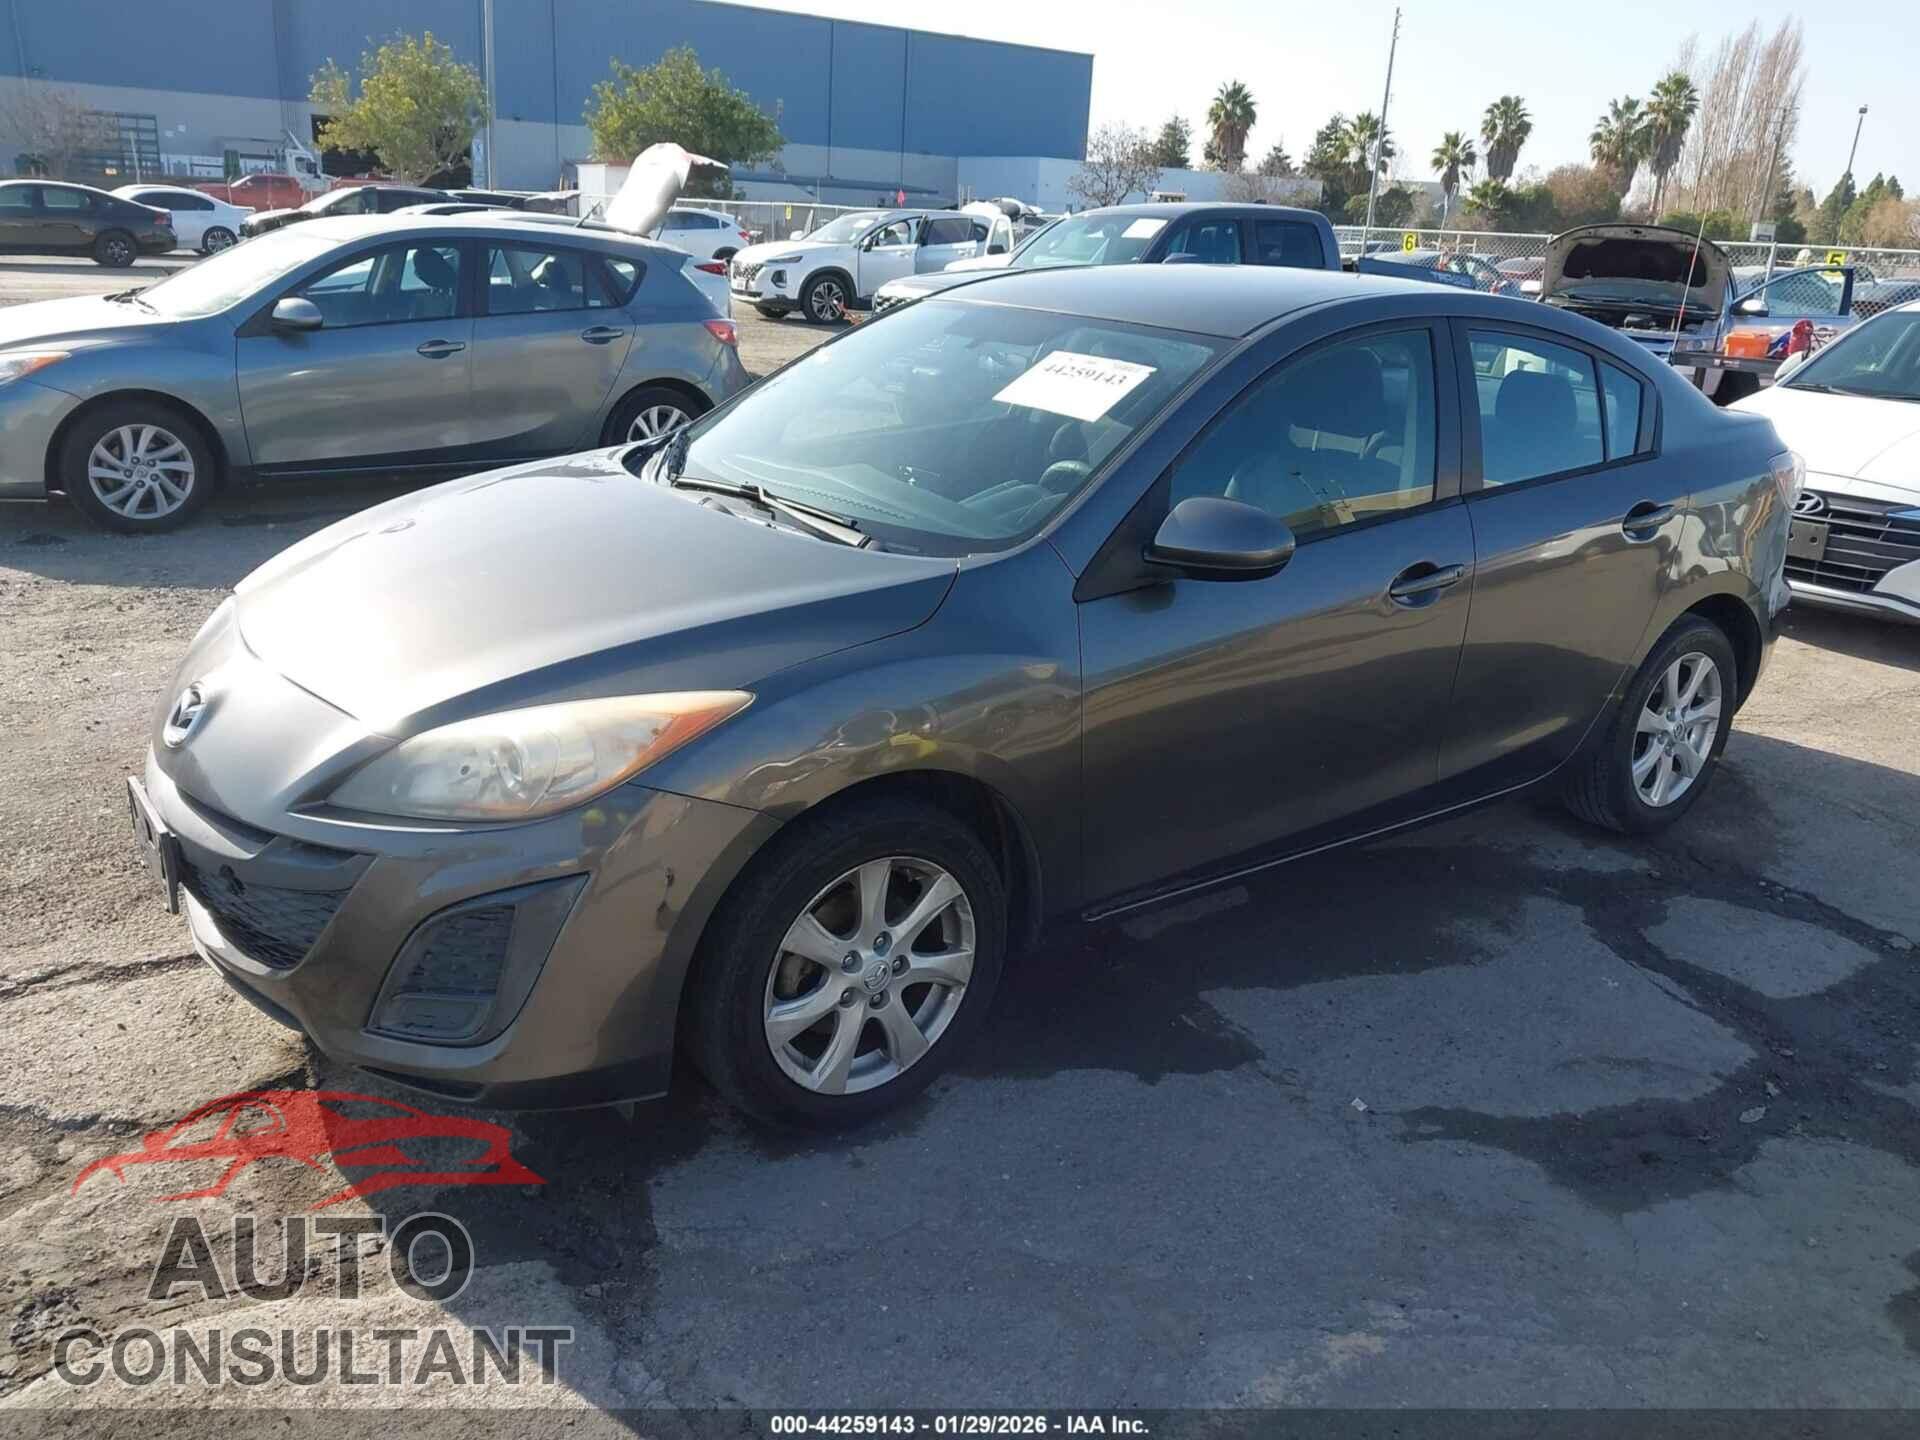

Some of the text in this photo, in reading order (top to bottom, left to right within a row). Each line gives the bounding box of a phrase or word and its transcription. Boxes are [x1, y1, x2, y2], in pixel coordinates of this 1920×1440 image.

[1405, 234, 1414, 251] 6
[1829, 253, 1842, 267] 5
[1043, 363, 1128, 385] 44259143
